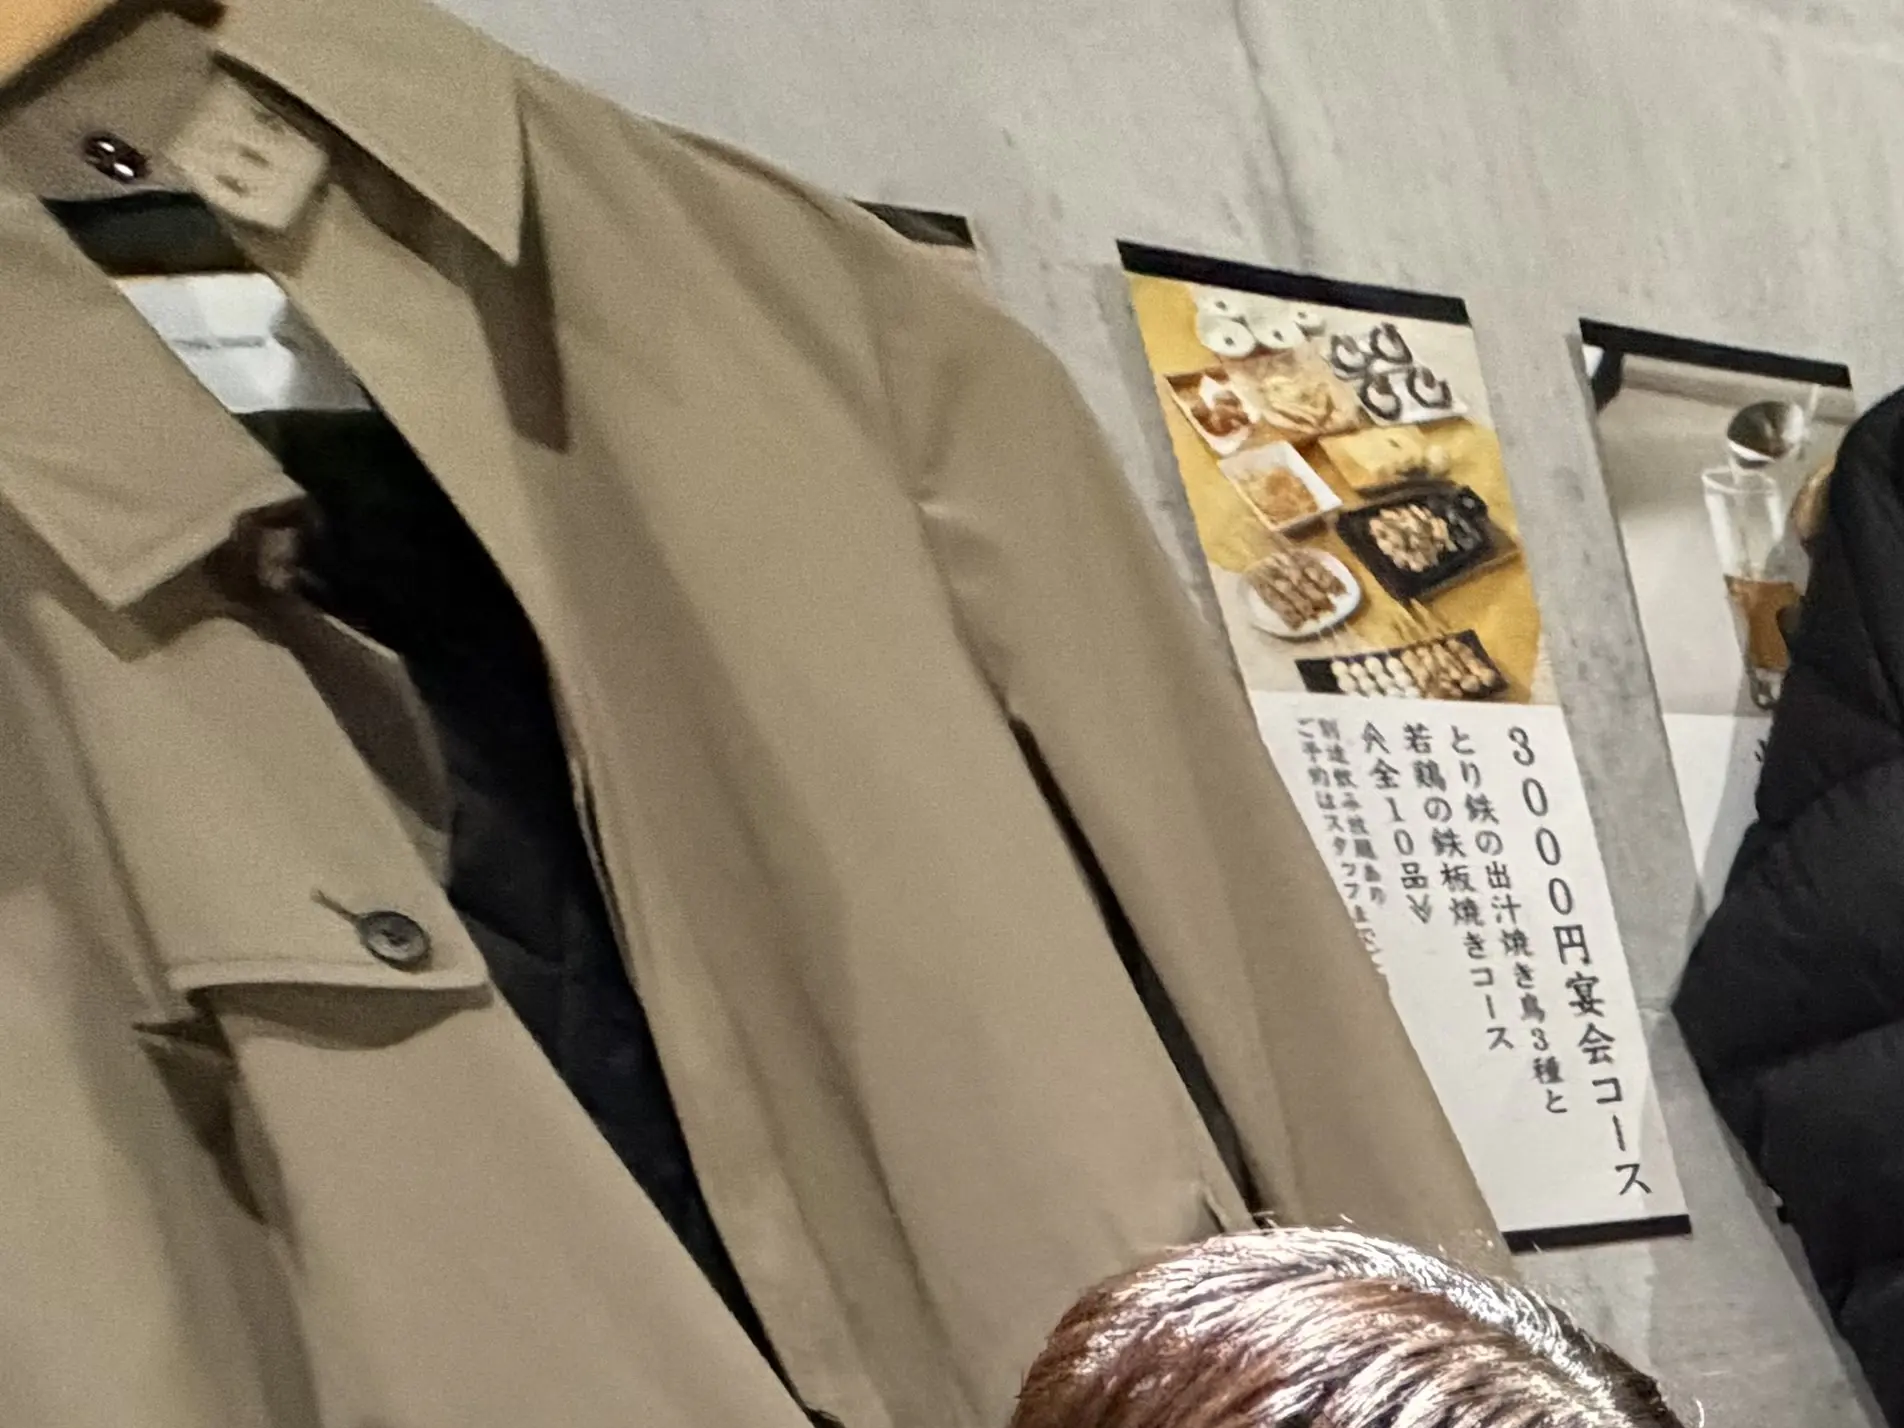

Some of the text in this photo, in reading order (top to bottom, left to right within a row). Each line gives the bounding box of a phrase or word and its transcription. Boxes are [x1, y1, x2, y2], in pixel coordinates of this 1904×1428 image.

[1402, 722, 1515, 1051] 若鶏の鉄板焼きコース
[1450, 724, 1568, 1115] とり鉄の出汁焼き鳥3種と
[1506, 726, 1653, 1197] 3000円宴会コース
